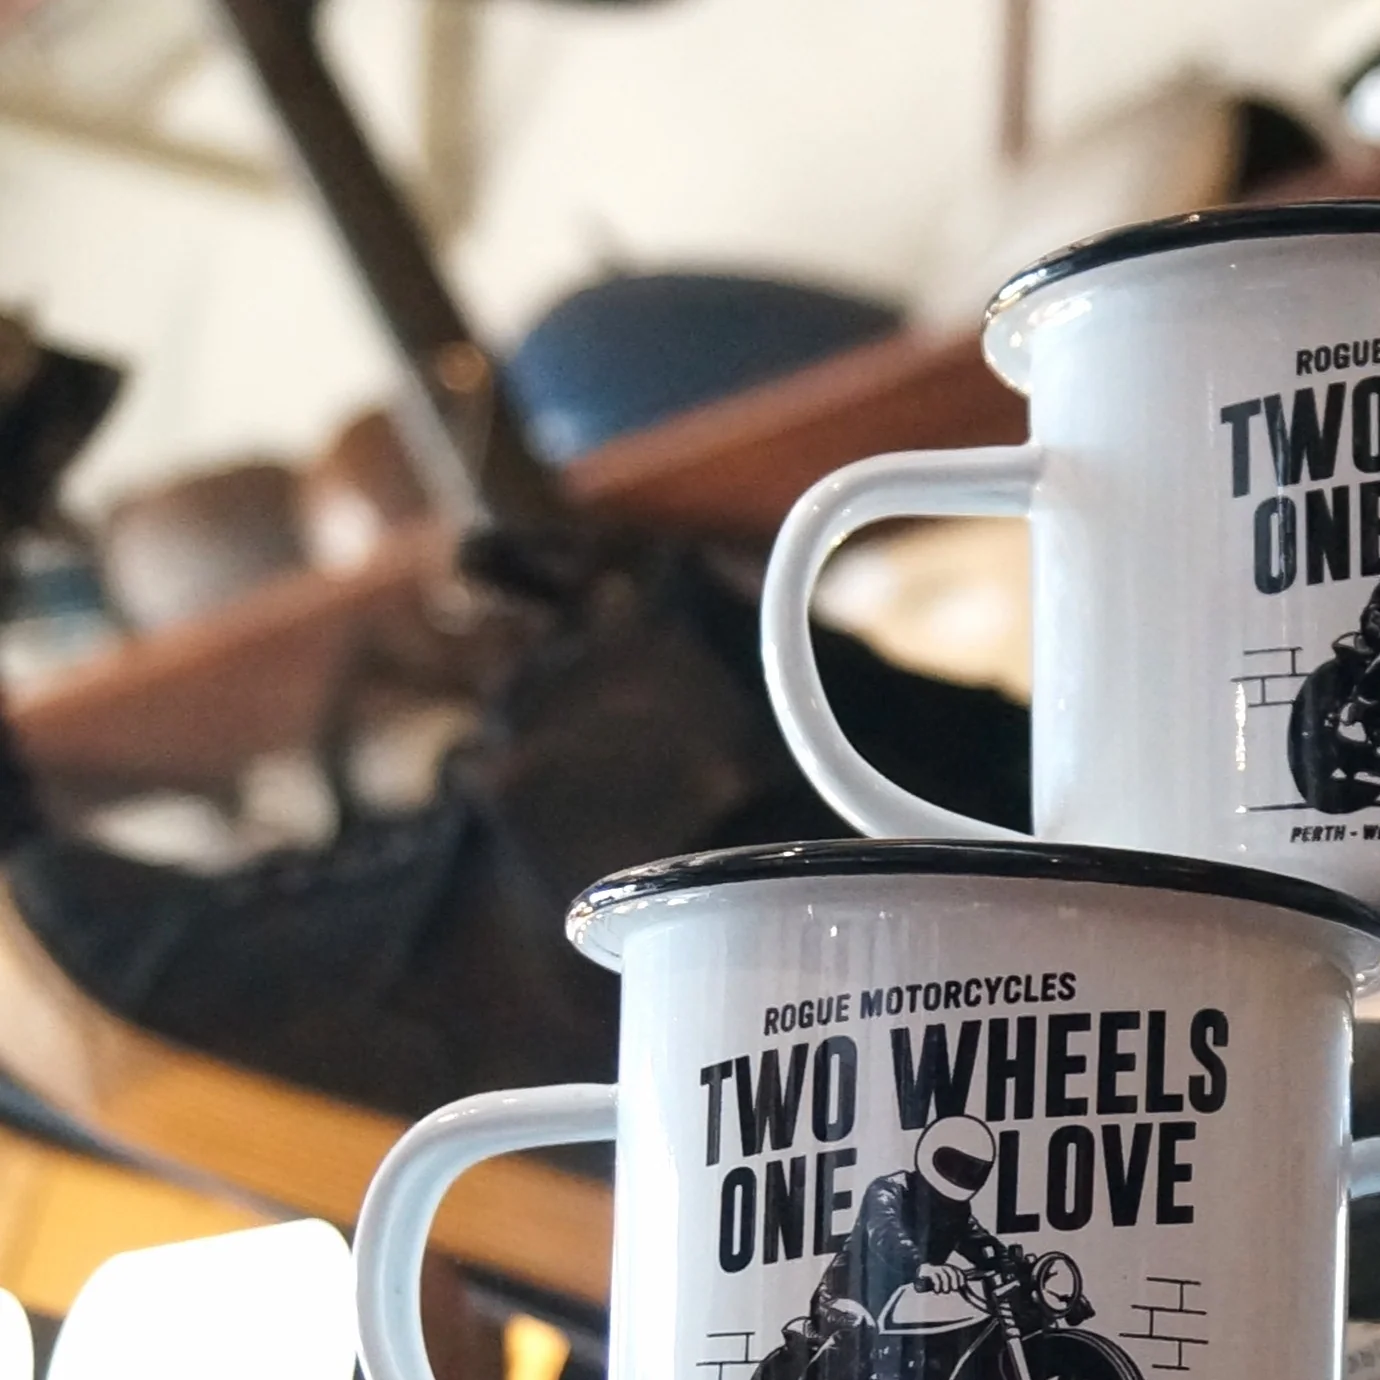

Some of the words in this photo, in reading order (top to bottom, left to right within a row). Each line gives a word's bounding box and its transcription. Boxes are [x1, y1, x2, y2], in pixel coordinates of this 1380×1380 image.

[1290, 824, 1346, 843] PERTH
[764, 993, 851, 1036] ROGUE
[859, 972, 1077, 1020] MOTORCYCLES
[700, 1034, 857, 1168] TWO
[890, 1007, 1230, 1132] WHEELS
[718, 1147, 858, 1274] ONE
[996, 1120, 1198, 1235] LOVE
